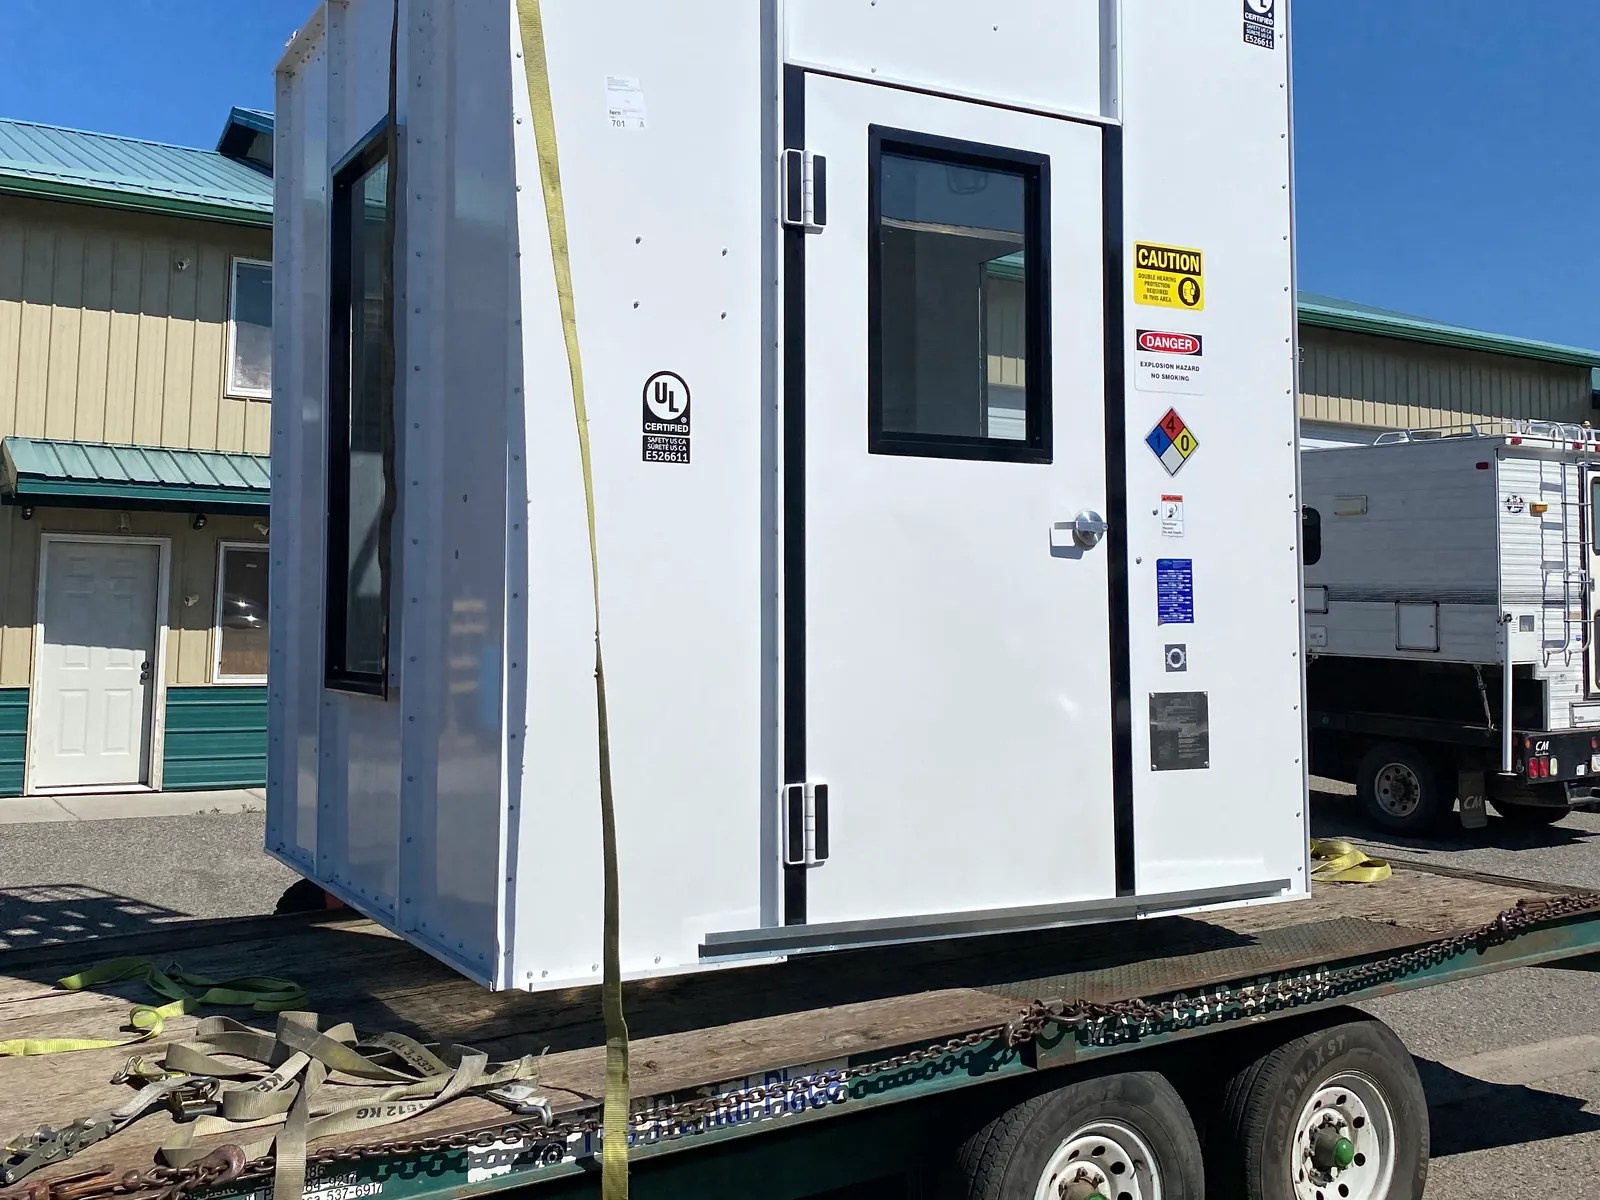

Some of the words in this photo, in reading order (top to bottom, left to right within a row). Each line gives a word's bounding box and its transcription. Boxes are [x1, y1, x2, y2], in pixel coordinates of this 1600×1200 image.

[1245, 12, 1273, 25] CERTIFIED
[1245, 34, 1273, 48] E526611
[612, 119, 625, 128] 701
[1138, 248, 1199, 272] CAUTION
[1138, 273, 1156, 281] DOUBLE
[1157, 274, 1177, 283] HEARING
[1144, 280, 1171, 289] PROTECTION
[1146, 287, 1169, 296] REQUIRED
[1146, 335, 1193, 351] DANGER
[1140, 360, 1175, 370] EXPLOSION
[1175, 364, 1200, 372] HAZARD
[1161, 373, 1190, 382] SMOKING
[655, 381, 679, 413] UL
[645, 422, 689, 433] CERTIFIED
[1166, 416, 1176, 433] 4
[647, 436, 669, 445] SAFETY
[1154, 434, 1161, 449] 1
[1181, 434, 1189, 451] 0
[645, 450, 688, 462] E526611
[1536, 740, 1549, 751] CM
[1464, 795, 1483, 809] CM
[1327, 1034, 1346, 1057] ST
[356, 1106, 382, 1120] KG
[305, 1171, 357, 1192] 84-9217
[327, 1182, 382, 1200] 537-6917
